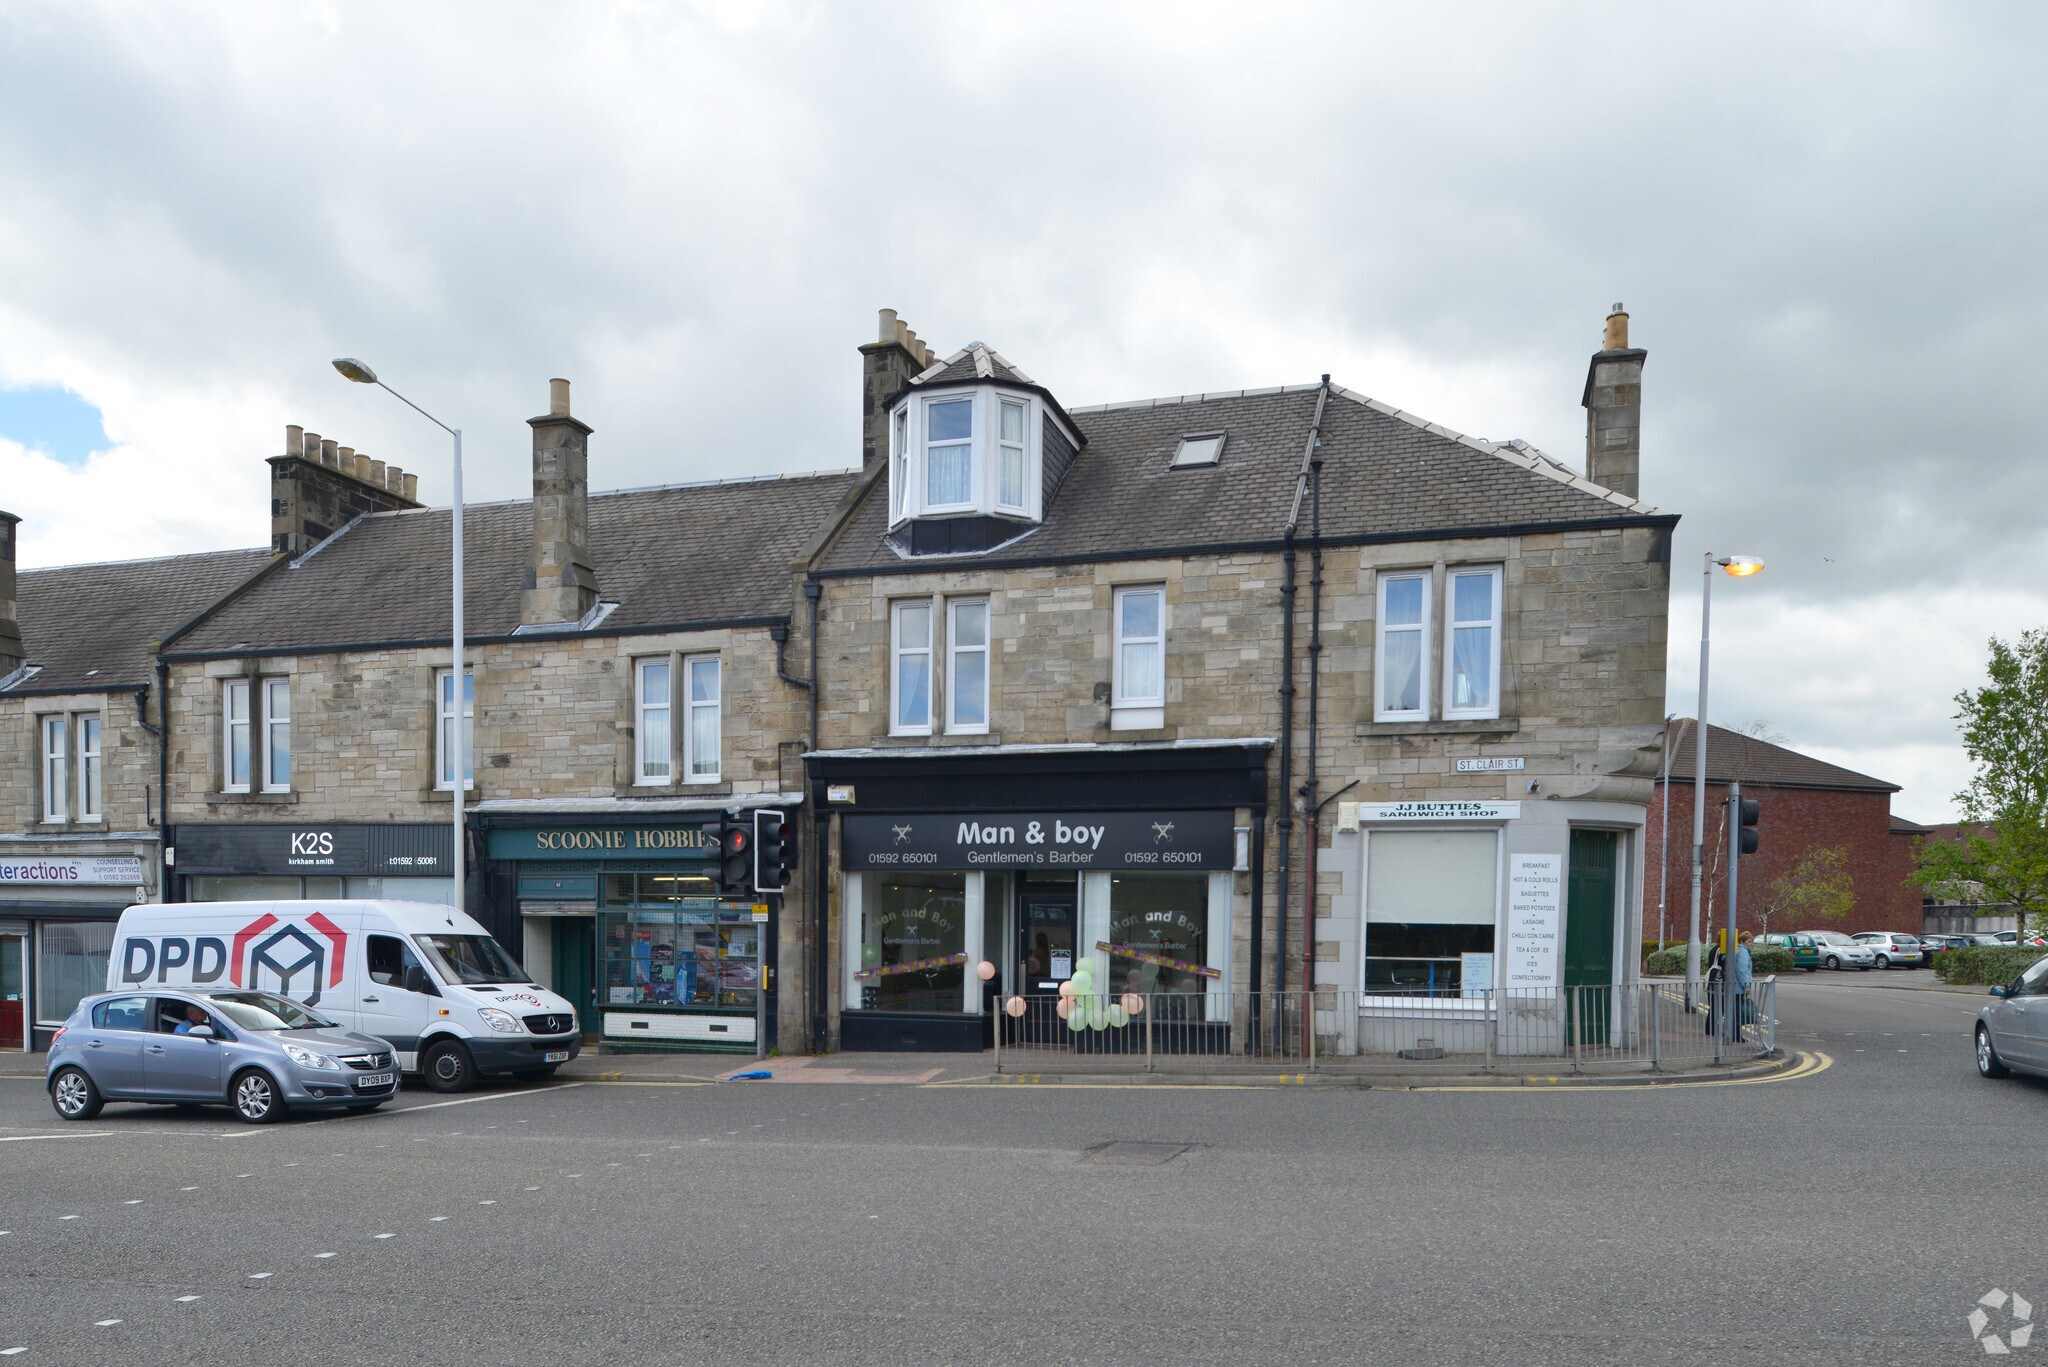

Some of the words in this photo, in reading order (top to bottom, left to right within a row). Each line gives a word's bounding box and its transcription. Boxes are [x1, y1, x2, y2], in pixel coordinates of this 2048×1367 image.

[1459, 761, 1475, 770] ST.
[1476, 759, 1504, 769] CLAIR
[1507, 758, 1522, 768] ST.
[1416, 803, 1482, 811] BUTTIES
[537, 830, 626, 849] SCOONIE
[956, 822, 1015, 845] Man
[1025, 821, 1046, 845] &
[1055, 820, 1105, 850] boy
[291, 832, 333, 855] K2S
[868, 853, 899, 863] 01592
[902, 853, 938, 863] 650101
[967, 851, 1044, 863] Gentlemen's
[1049, 851, 1094, 863] Barber
[1124, 852, 1158, 863] 01592
[1162, 852, 1202, 863] 650101
[902, 908, 927, 919] and
[931, 912, 955, 933] Boy
[1109, 914, 1139, 935] Man
[1144, 910, 1173, 922] and
[1177, 914, 1203, 938] Boy
[921, 937, 941, 945] Barber
[122, 937, 227, 983] DPD
[361, 1075, 380, 1086] DY09
